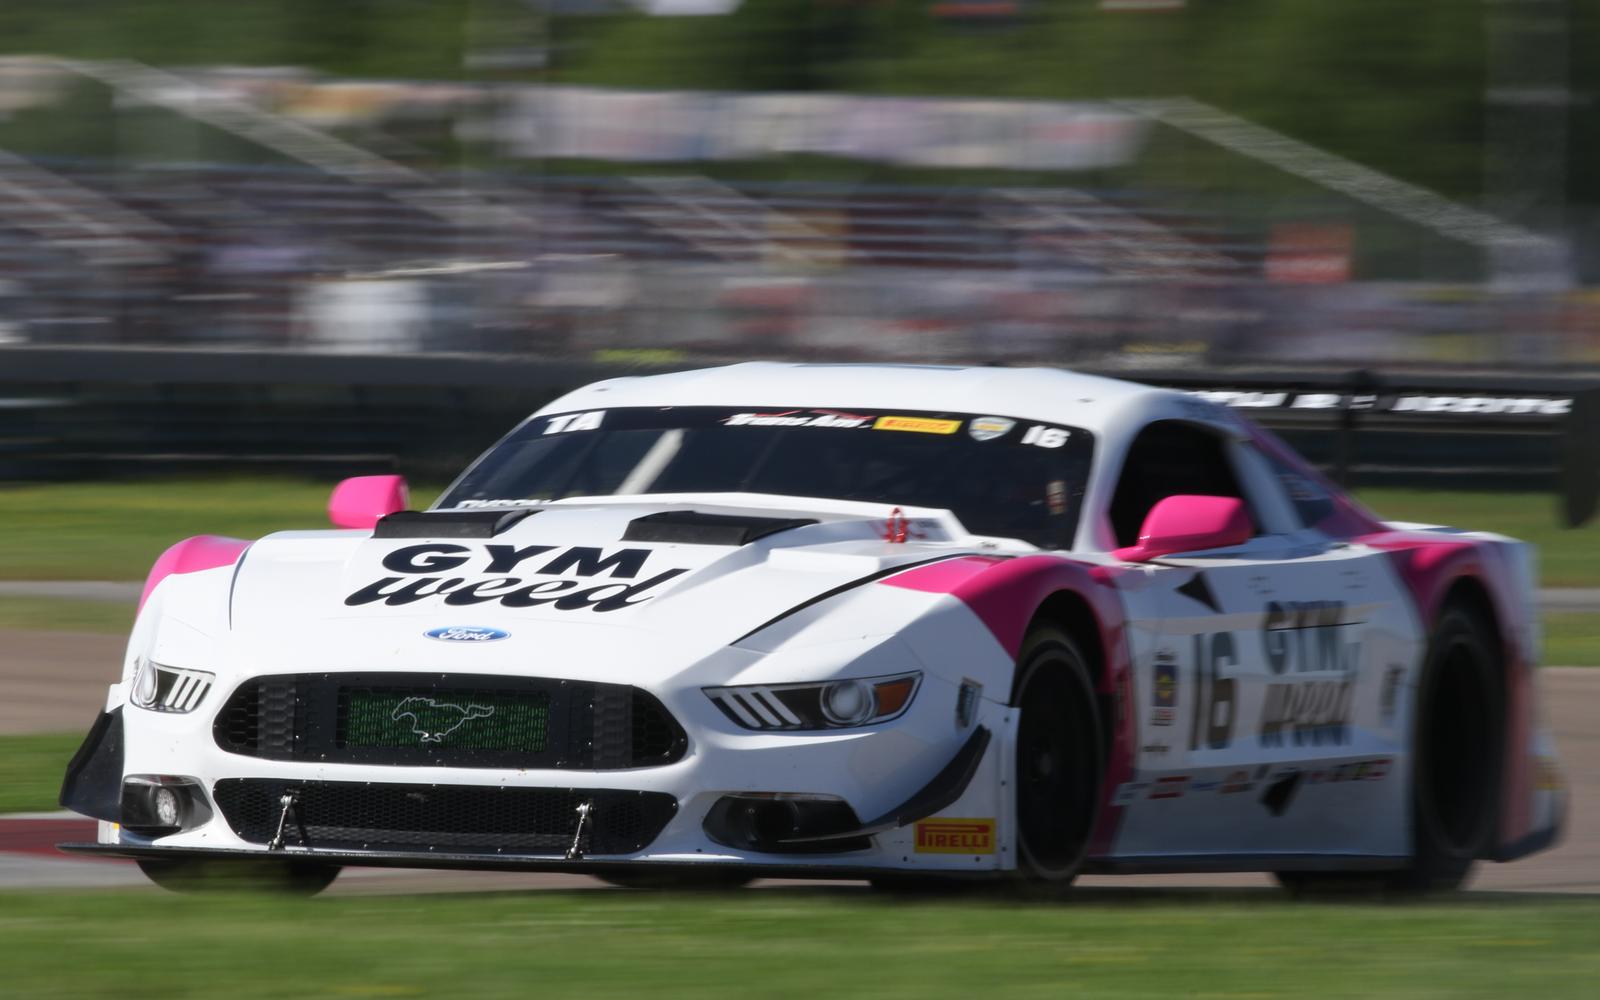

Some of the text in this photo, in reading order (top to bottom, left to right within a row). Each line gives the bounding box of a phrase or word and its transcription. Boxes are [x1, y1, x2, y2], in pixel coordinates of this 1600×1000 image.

[543, 410, 607, 435] TA
[1020, 424, 1071, 449] 16
[382, 543, 652, 579] GYM
[344, 568, 691, 612] weed
[438, 625, 496, 641] Ford
[1187, 631, 1241, 751] 16
[917, 822, 991, 849] PIRELLI
